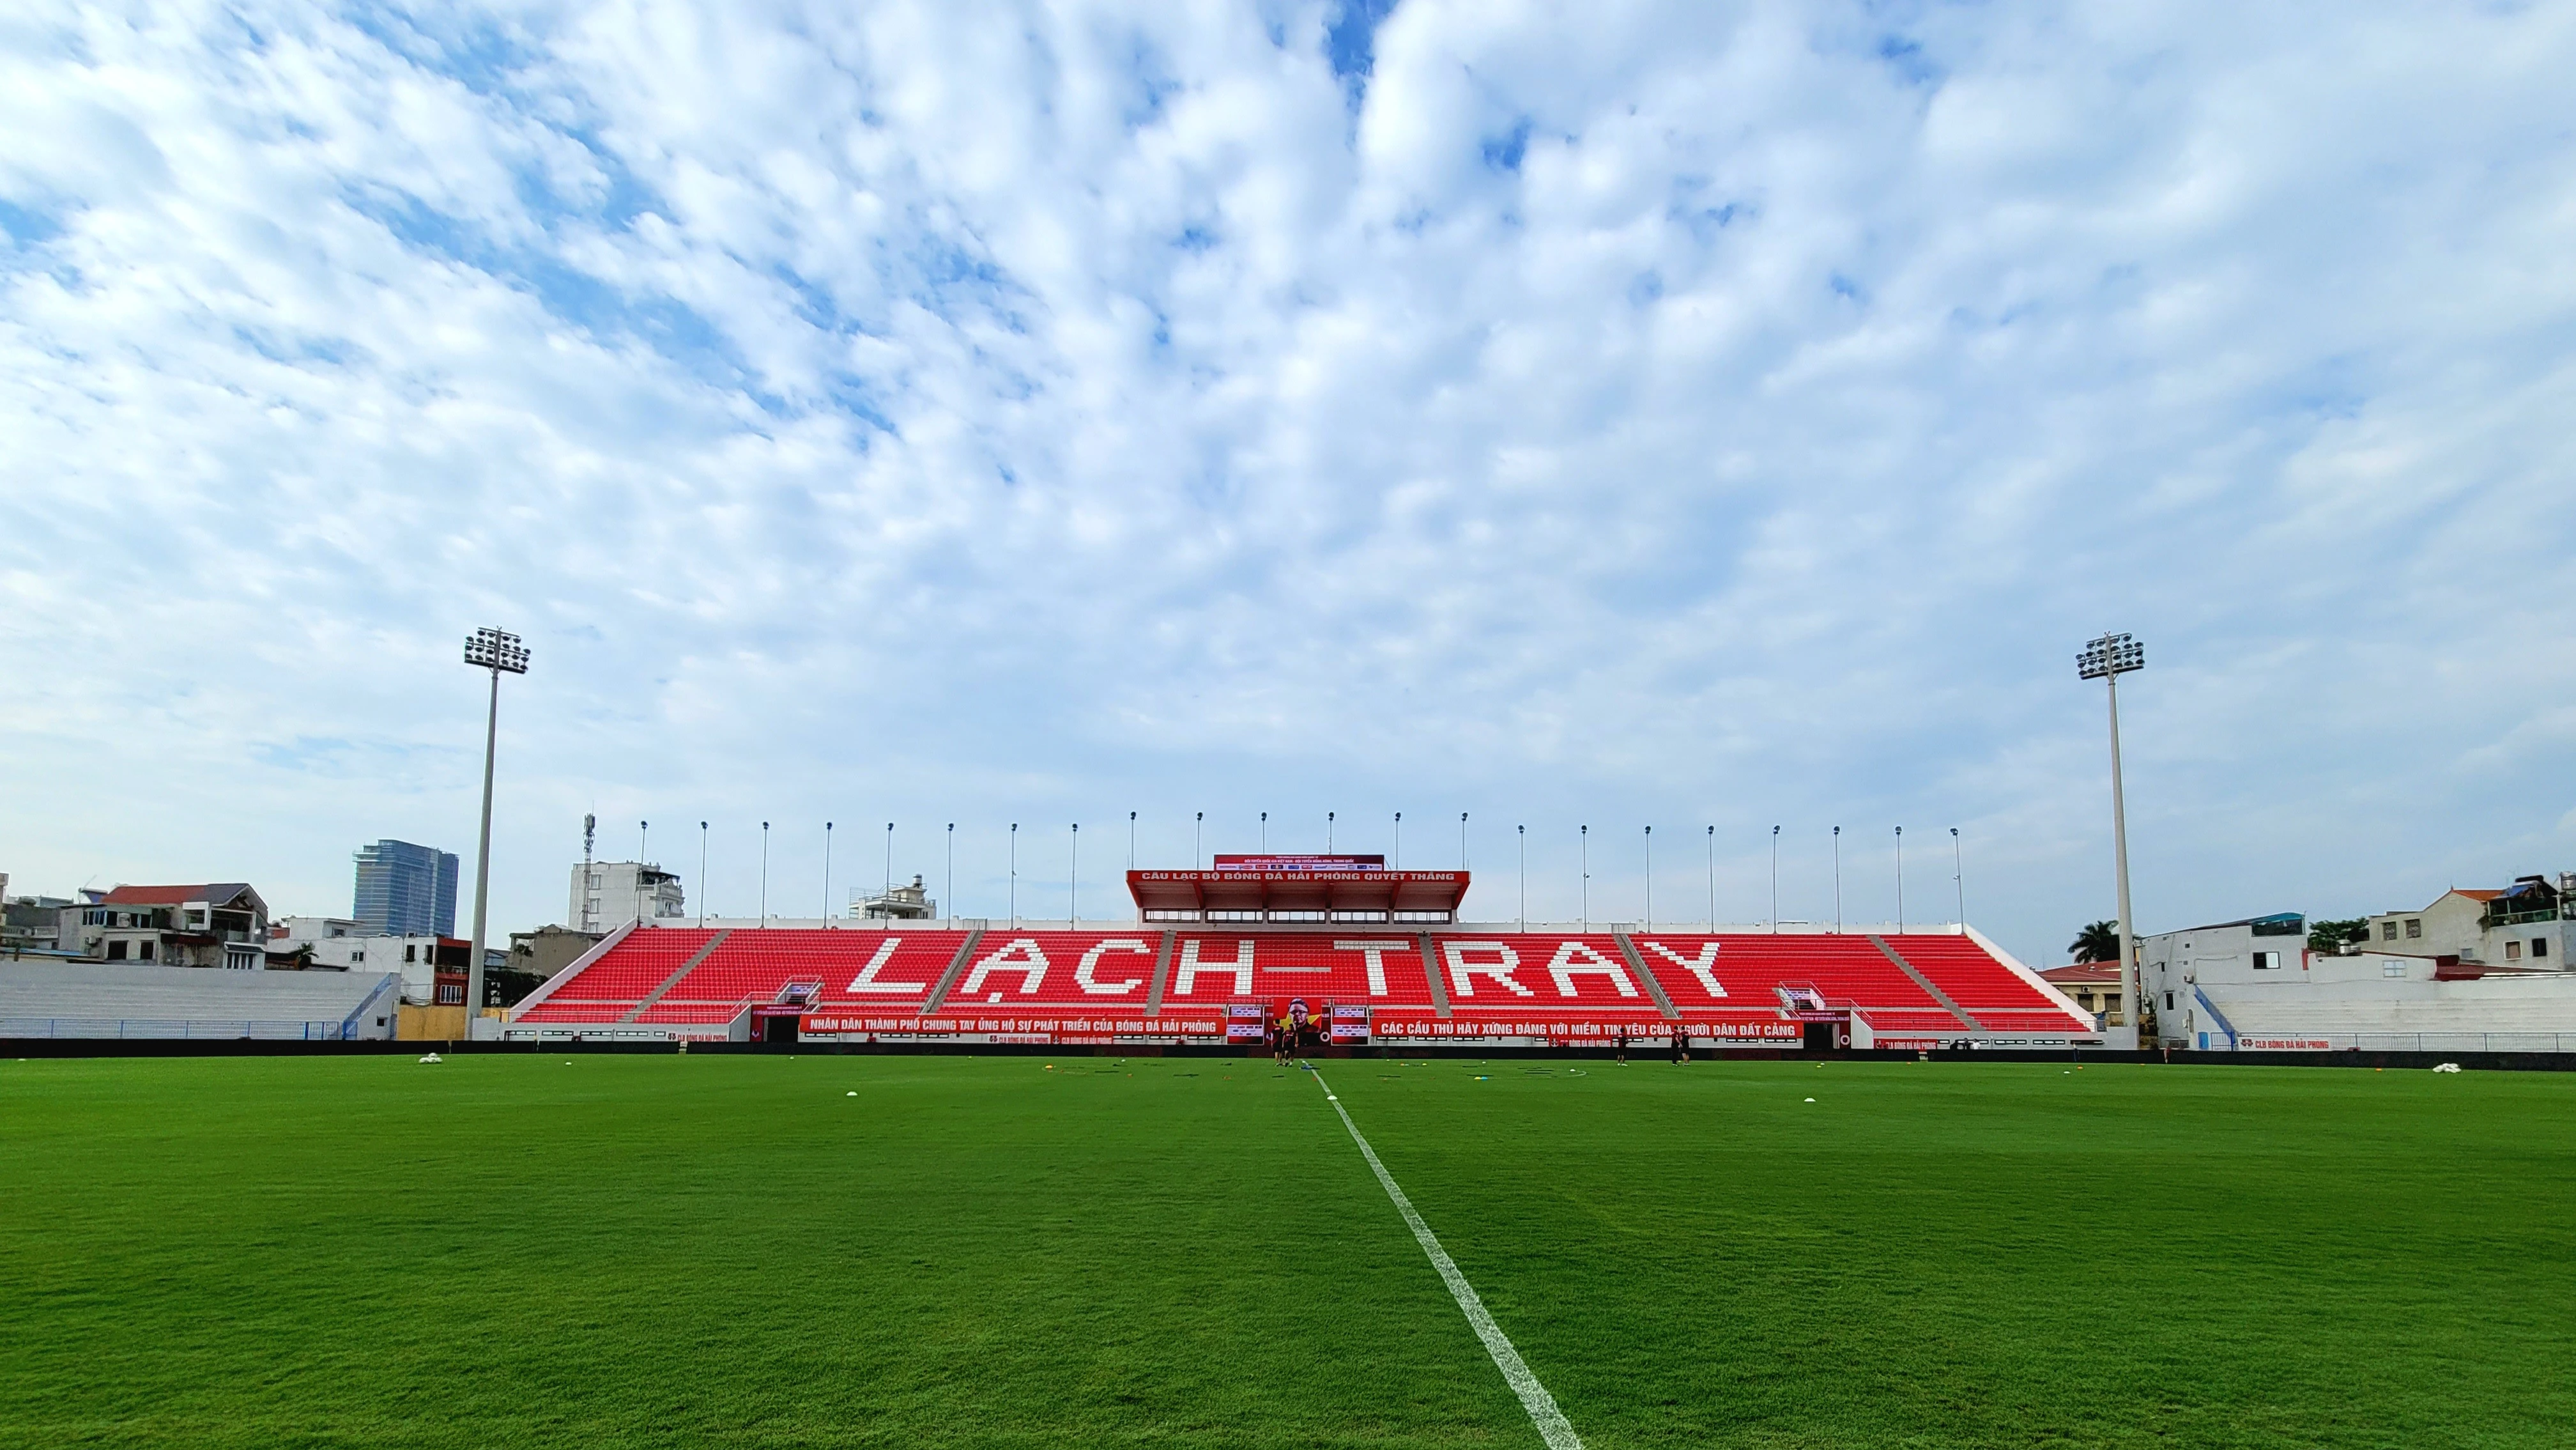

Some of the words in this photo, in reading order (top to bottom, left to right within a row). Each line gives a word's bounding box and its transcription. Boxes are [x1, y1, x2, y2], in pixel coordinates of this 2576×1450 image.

[1142, 871, 1169, 879] CÂU
[1172, 872, 1198, 881] LẠC
[1202, 872, 1220, 881] BỘ
[1224, 871, 1261, 879] BÓNG
[1265, 871, 1283, 879] ĐÁ
[1287, 870, 1310, 880] HẢI
[1314, 871, 1360, 880] PHÒNG
[1365, 871, 1406, 880] QUYẾT
[1410, 870, 1455, 880] THẮNG
[1333, 940, 1728, 997] TRAY
[810, 1017, 838, 1030] NHÂN
[841, 1017, 862, 1030] DÂN
[864, 1017, 897, 1030] THÀNH
[900, 1016, 920, 1030] PHỐ
[923, 1019, 956, 1030] CHUNG
[959, 1020, 976, 1030] TAY
[978, 1017, 999, 1030] ỨNG
[1002, 1018, 1015, 1033] HỘ
[1018, 1021, 1032, 1033] SỰ
[1034, 1019, 1059, 1031] PHÁT
[1062, 1018, 1091, 1031] TRIỂN
[1093, 1018, 1113, 1031] CỦA
[1116, 1019, 1143, 1031] BÓNG
[1146, 1019, 1160, 1031] ĐÁ
[1162, 1018, 1179, 1032] HẢI
[1181, 1019, 1216, 1032] PHÒNG
[1381, 1021, 1404, 1034] CÁC
[1407, 1021, 1430, 1034] CẦU
[1432, 1020, 1454, 1034] THỦ
[1457, 1021, 1479, 1034] HÃY
[1482, 1021, 1513, 1034] XỨNG
[1516, 1021, 1547, 1035] ĐÁNG
[1549, 1021, 1568, 1035] VỚI
[1572, 1021, 1600, 1035] NIỀM
[1604, 1024, 1621, 1035] TIN
[1625, 1022, 1646, 1035] YÊU
[1650, 1021, 1672, 1035] CỦA
[1713, 1023, 1736, 1036] DÂN
[1740, 1022, 1760, 1036] ĐẤT
[1765, 1022, 1795, 1036] CẢNG
